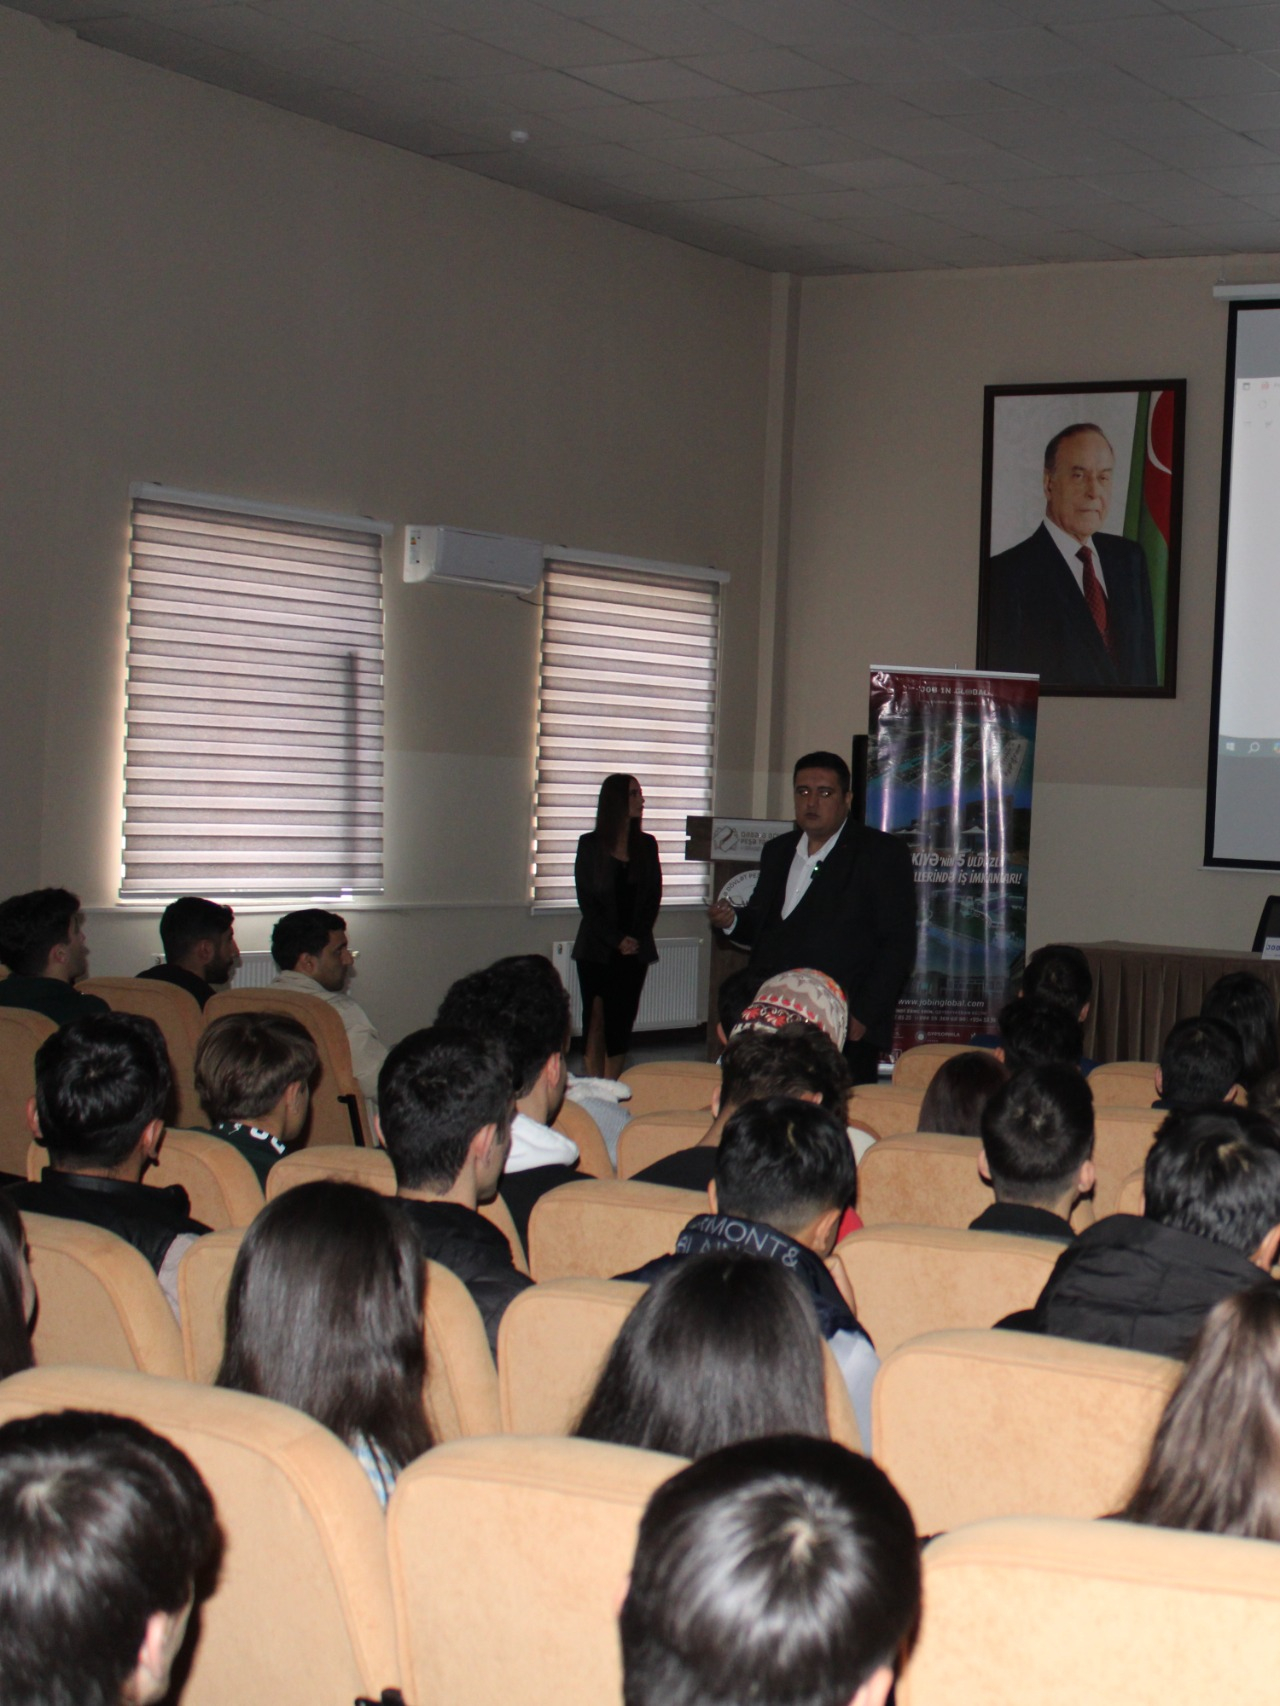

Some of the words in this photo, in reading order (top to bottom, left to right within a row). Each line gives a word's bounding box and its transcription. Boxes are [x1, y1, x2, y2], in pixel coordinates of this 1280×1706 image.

[958, 854, 965, 866] 5
[958, 870, 967, 885] İŞ
[898, 999, 984, 1007] www.jobinglobal.com
